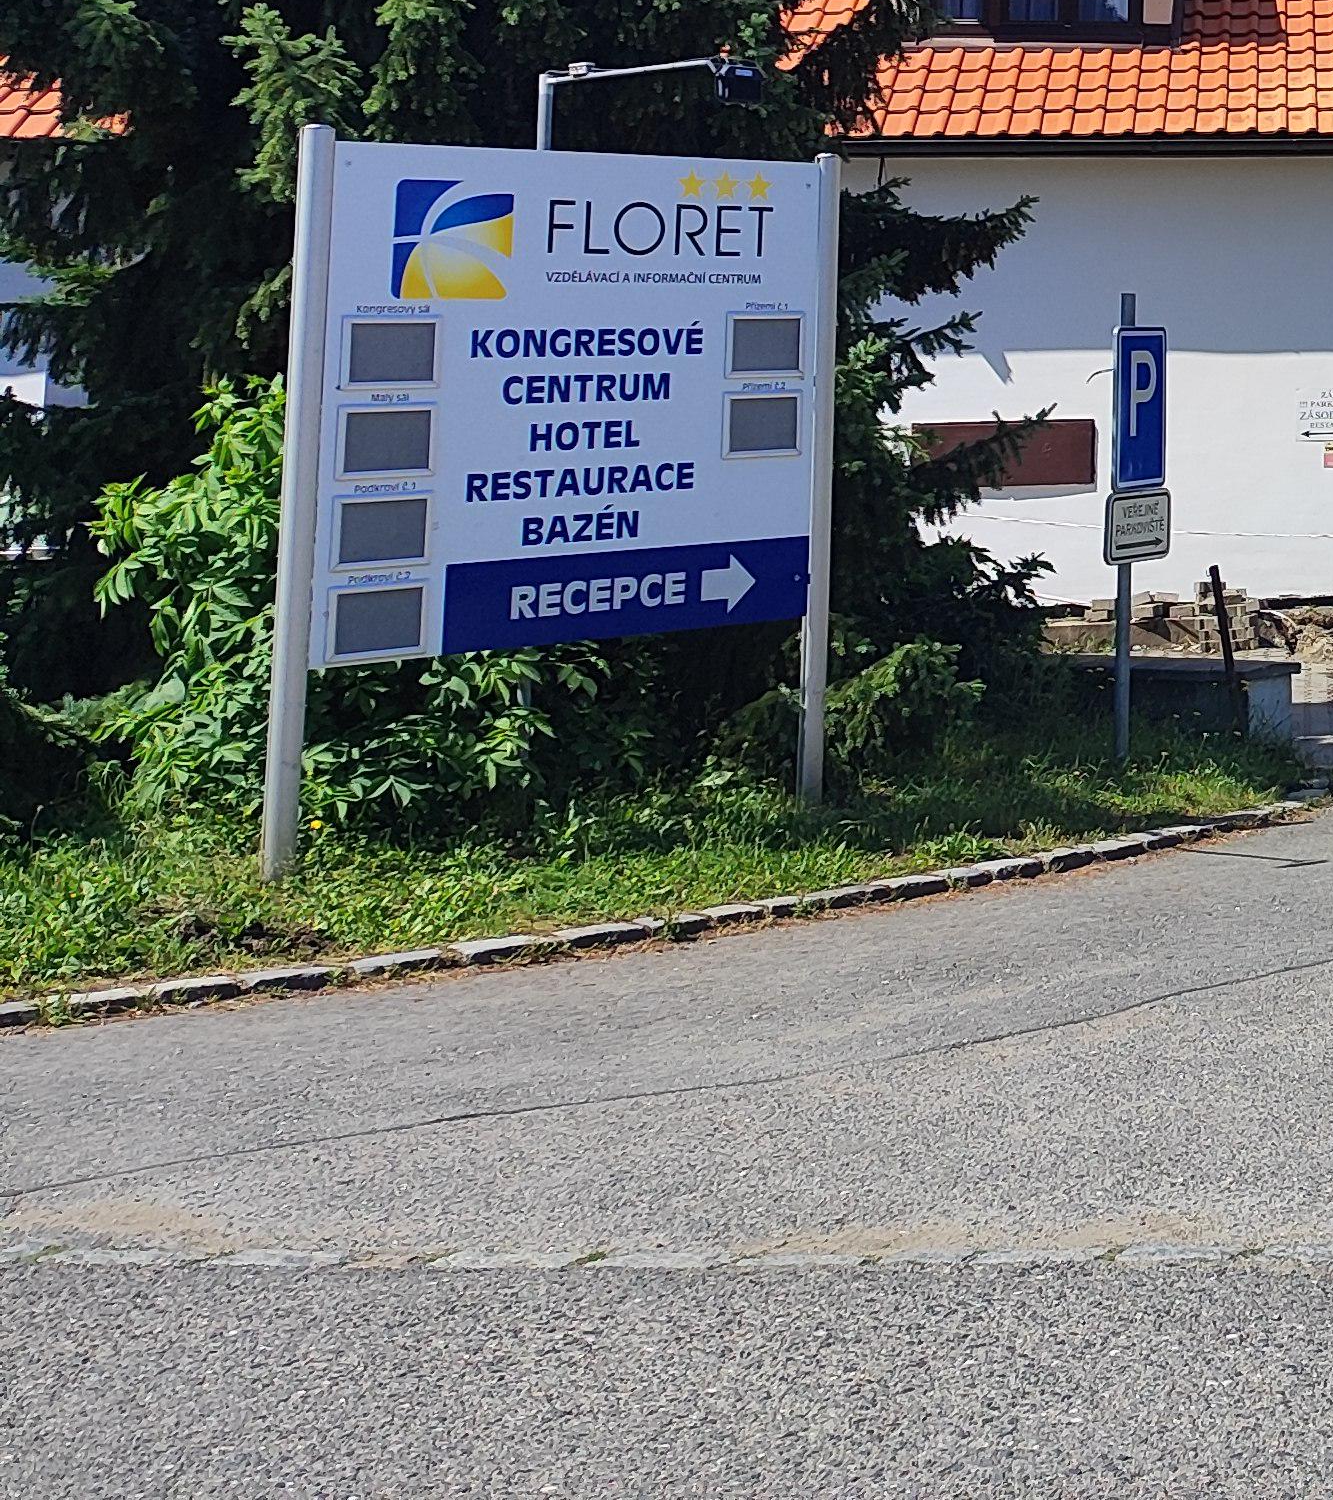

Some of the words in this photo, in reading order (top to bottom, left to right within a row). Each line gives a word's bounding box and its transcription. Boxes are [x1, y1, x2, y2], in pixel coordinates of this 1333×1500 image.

[547, 199, 774, 257] FLORET
[546, 270, 620, 283] VZDĚLÁVACÍ
[622, 272, 631, 283] A
[633, 271, 706, 284] INFORMAČNÍ
[709, 273, 761, 284] CENTRUM
[470, 320, 704, 359] KONGRESOVÉ
[502, 372, 671, 405] CENTRUM
[1129, 350, 1157, 437] P
[529, 419, 640, 452] HOTEL
[465, 461, 695, 503] RESTAURACE
[521, 503, 639, 547] BAZÉN
[509, 572, 687, 621] RECEPCE
